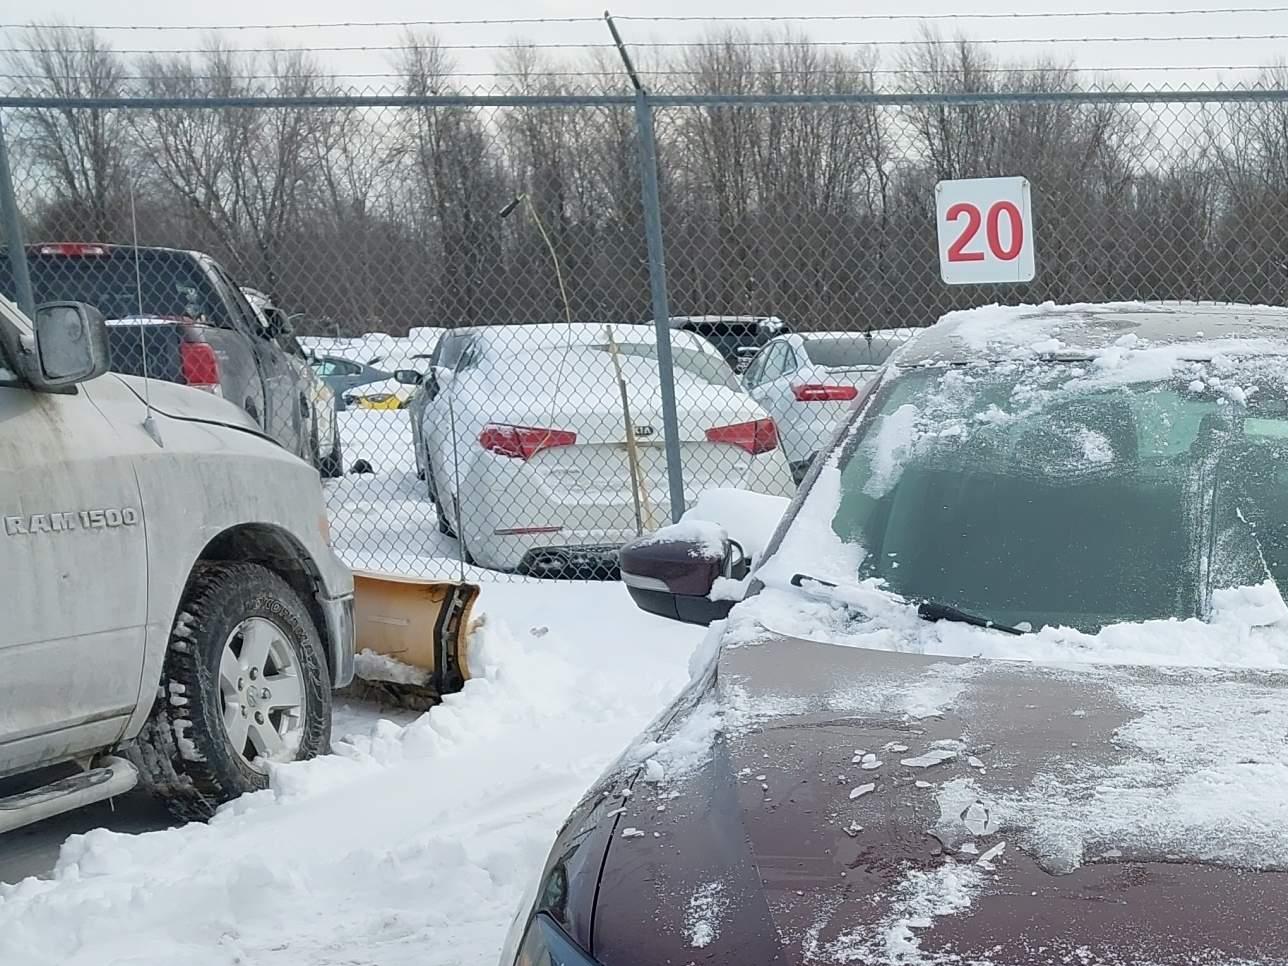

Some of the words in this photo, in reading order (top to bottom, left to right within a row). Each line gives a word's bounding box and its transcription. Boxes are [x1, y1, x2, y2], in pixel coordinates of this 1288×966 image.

[945, 200, 1024, 263] 20
[5, 511, 75, 535] RAM
[79, 507, 138, 530] 1500
